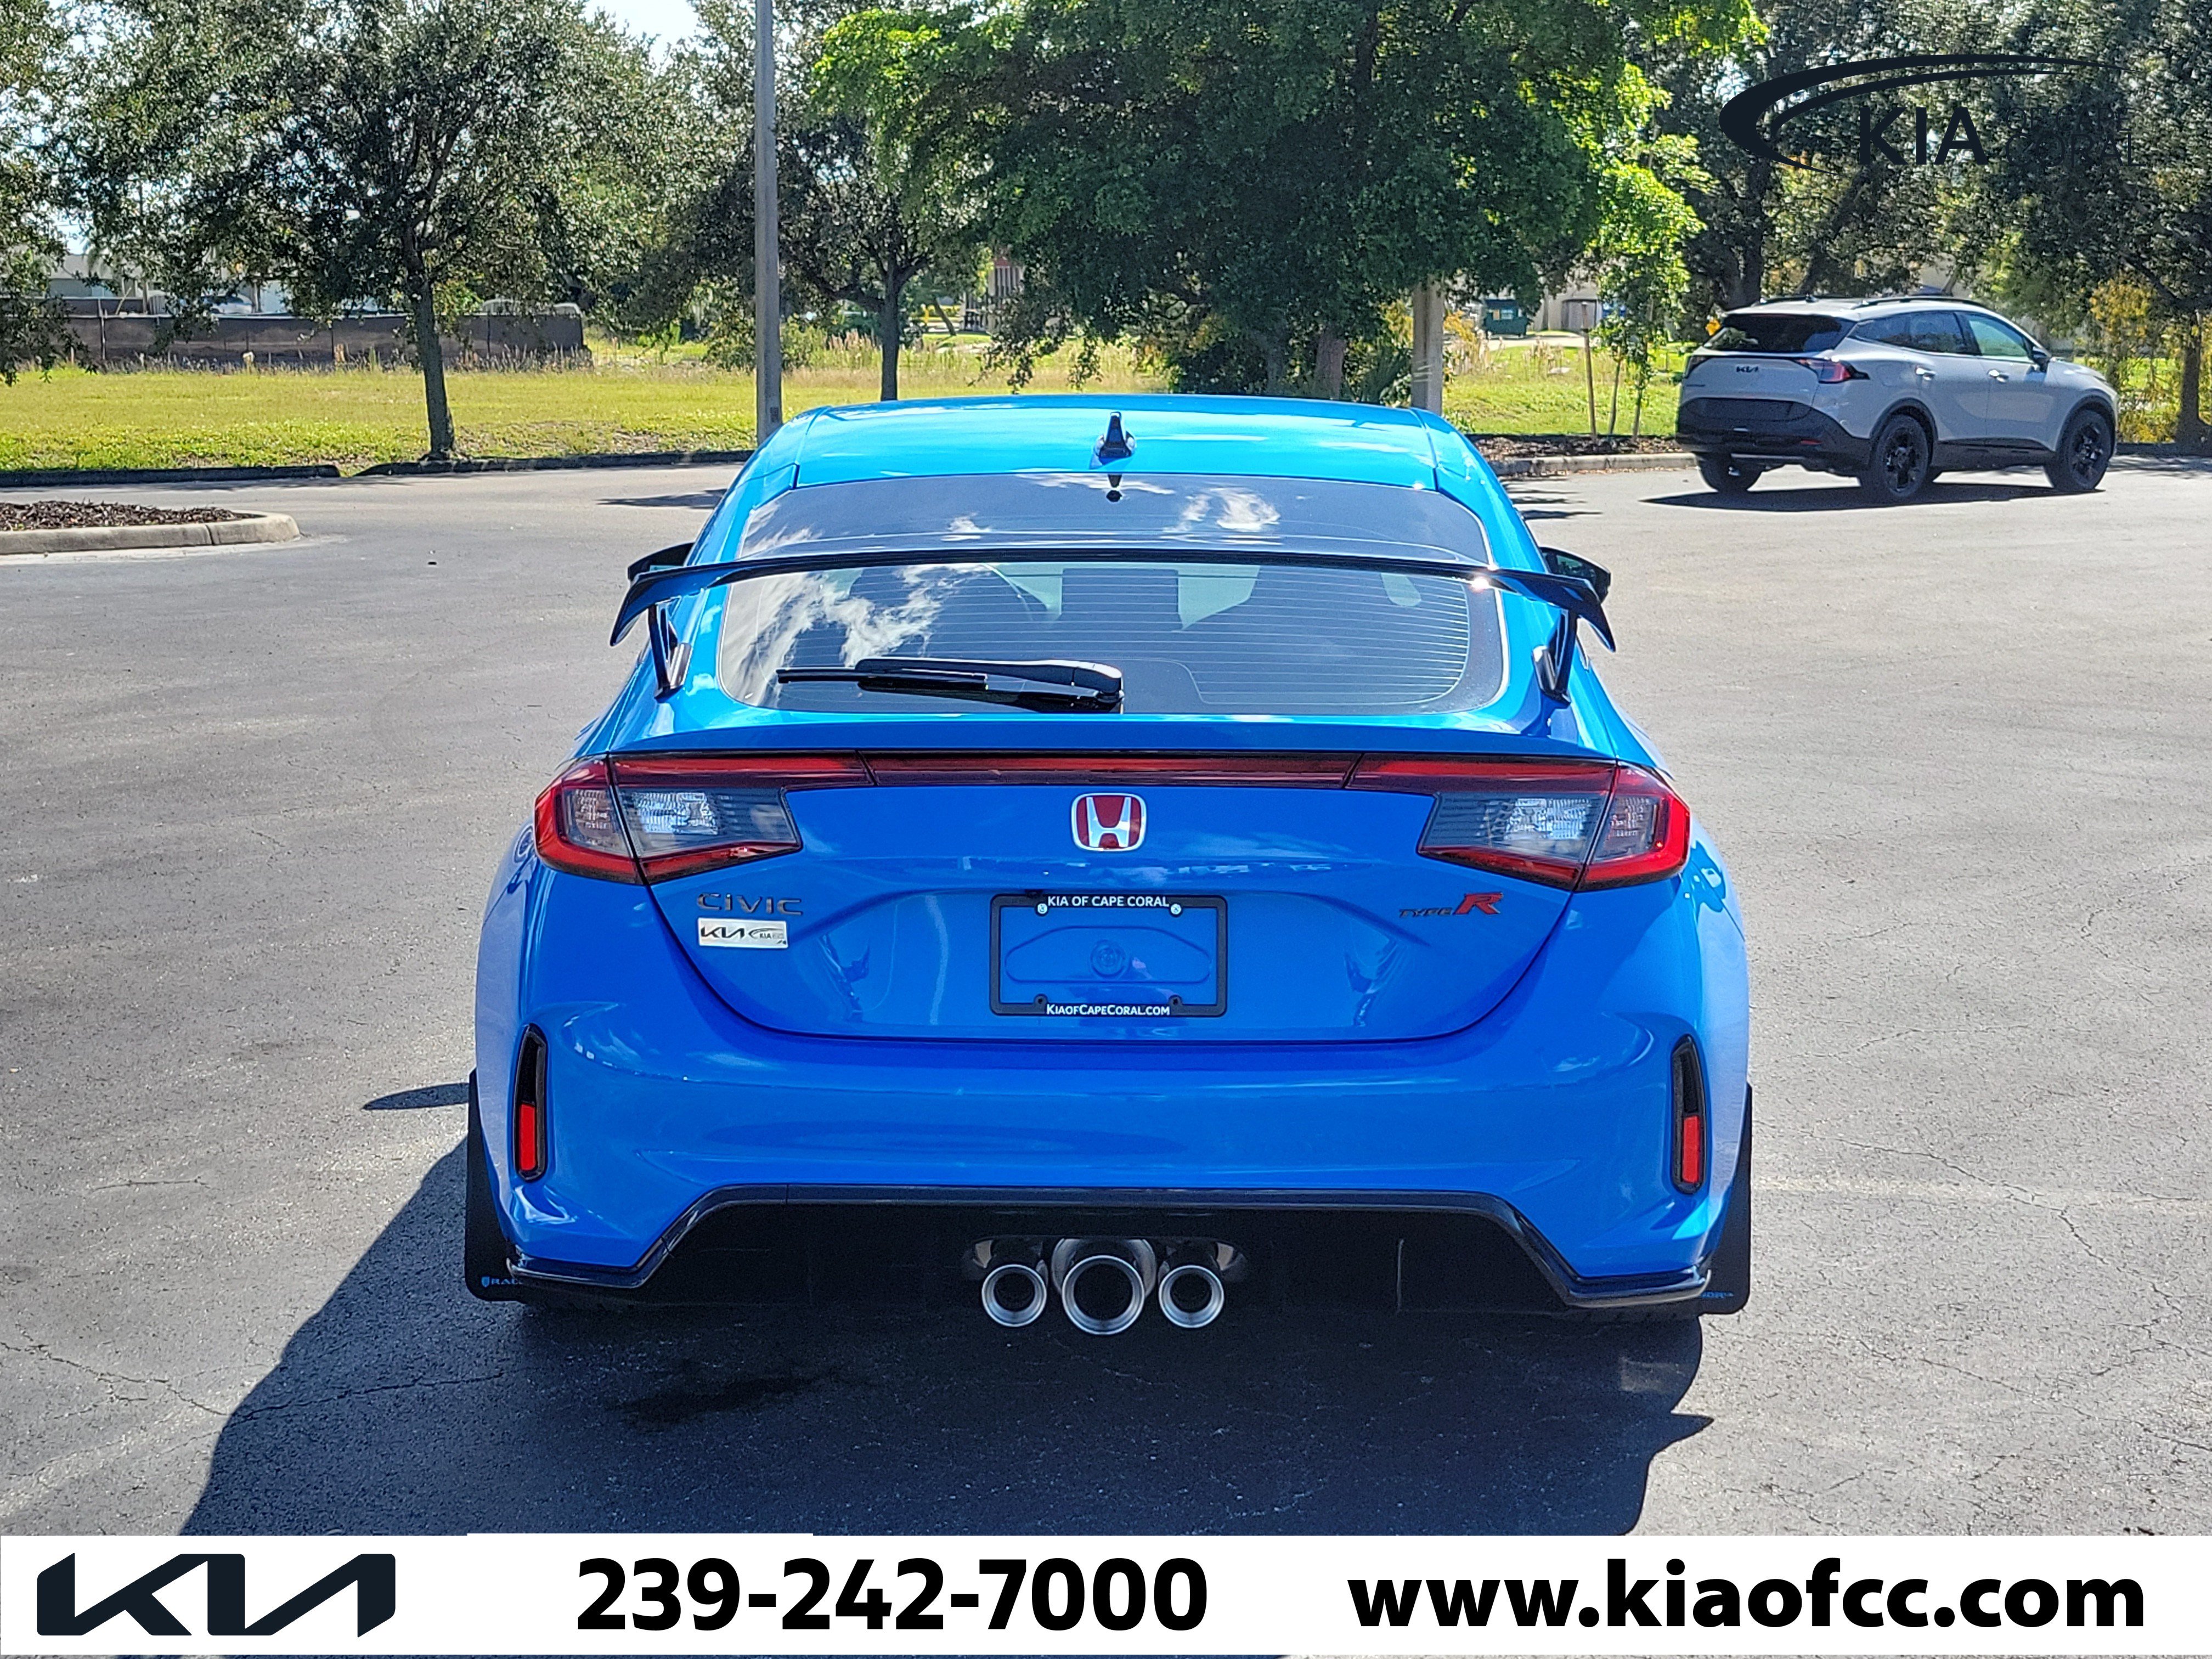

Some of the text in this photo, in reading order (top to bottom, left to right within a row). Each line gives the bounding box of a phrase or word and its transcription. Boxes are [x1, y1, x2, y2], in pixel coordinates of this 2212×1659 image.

[697, 893, 804, 916] CIVIC
[1048, 896, 1170, 907] KIA OF CAPE CORAL
[1400, 891, 1504, 918] TYPE R
